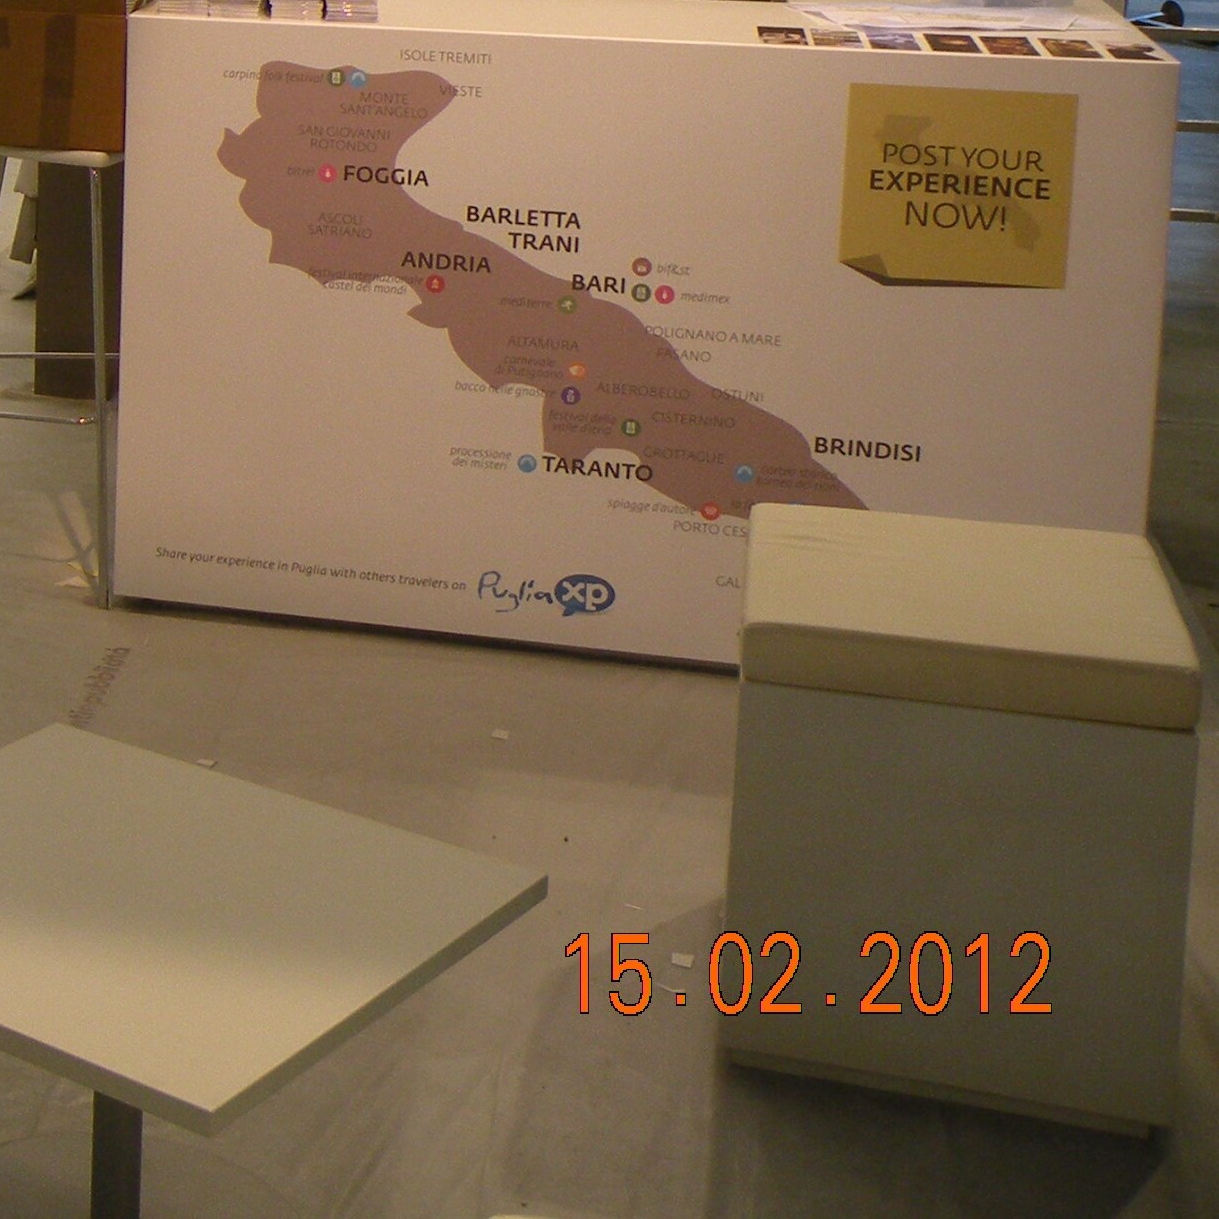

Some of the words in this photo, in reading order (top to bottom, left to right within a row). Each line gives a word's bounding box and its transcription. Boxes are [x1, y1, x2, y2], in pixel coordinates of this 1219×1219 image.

[400, 49, 437, 62] ISOLE
[438, 51, 492, 65] TREMITI
[360, 92, 409, 105] MONTE
[439, 84, 483, 98] VIESTE
[326, 126, 390, 141] GIOVANNI
[310, 138, 378, 153] ROTONDO
[883, 143, 956, 167] POST
[961, 147, 1044, 172] YOUR
[343, 165, 429, 187] FOGGIA
[869, 169, 1051, 201] EXPERIENCE
[466, 205, 581, 230] BARLETTA
[905, 201, 1007, 232] NOW!
[508, 232, 580, 254] TRANI
[401, 251, 492, 274] ANDRIA
[571, 274, 626, 295] BARI
[644, 324, 727, 343] POLIGNANO
[729, 330, 739, 343] A
[741, 332, 781, 347] MARE
[814, 437, 922, 464] BRINDISI
[542, 456, 653, 482] TARANTO
[673, 521, 719, 537] PORTO
[155, 547, 187, 562] Share
[189, 551, 214, 564] your
[216, 554, 275, 571] experience
[277, 559, 288, 572] in
[291, 562, 327, 579] Puglia
[330, 567, 356, 580] with
[360, 570, 395, 584] others
[398, 573, 449, 590] travelers
[452, 580, 466, 590] on
[477, 570, 554, 613] Puglia
